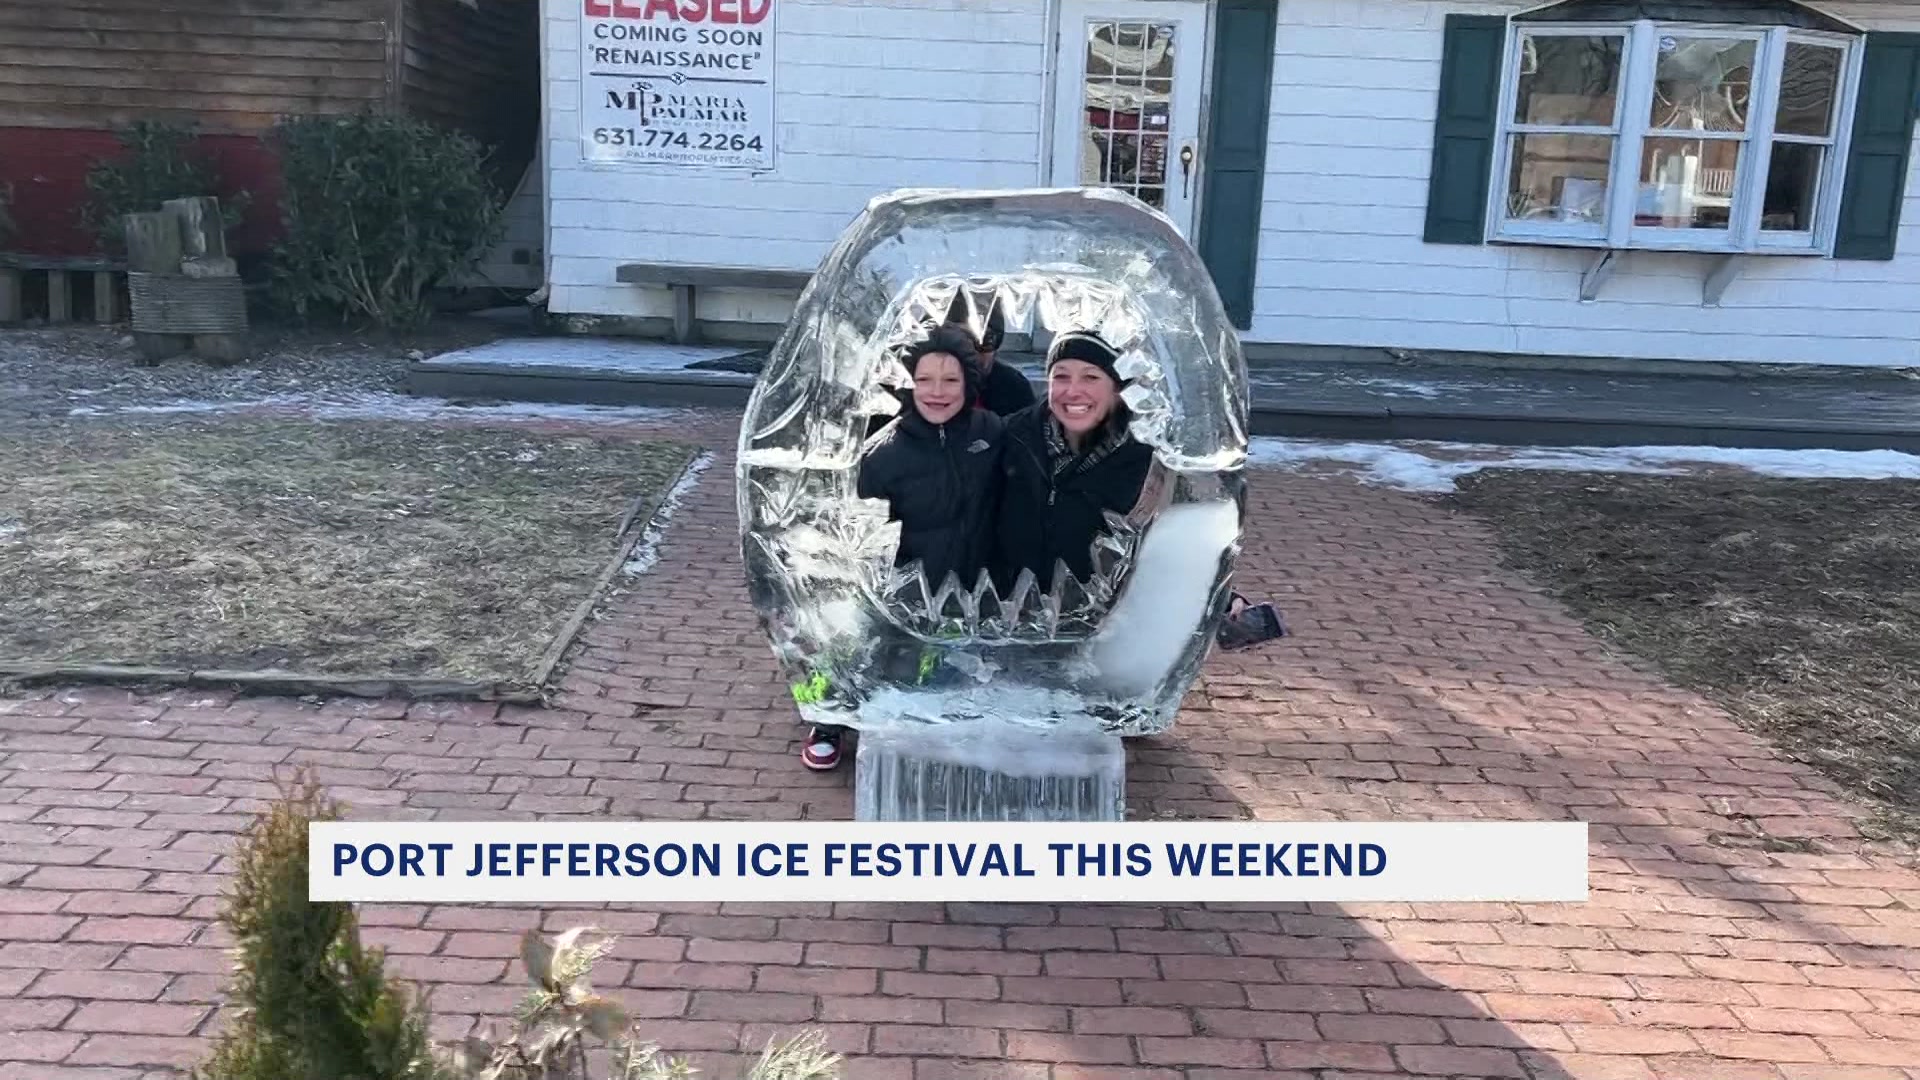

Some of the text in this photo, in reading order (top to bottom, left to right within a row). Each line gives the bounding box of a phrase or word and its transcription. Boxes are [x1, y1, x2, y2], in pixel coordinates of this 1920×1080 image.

[594, 23, 763, 46] COMING SOON
[588, 44, 761, 70] "RENAISSANCE"
[668, 94, 745, 108] MARIA
[651, 107, 749, 122] PALMAR
[594, 127, 764, 152] 631.774.2264
